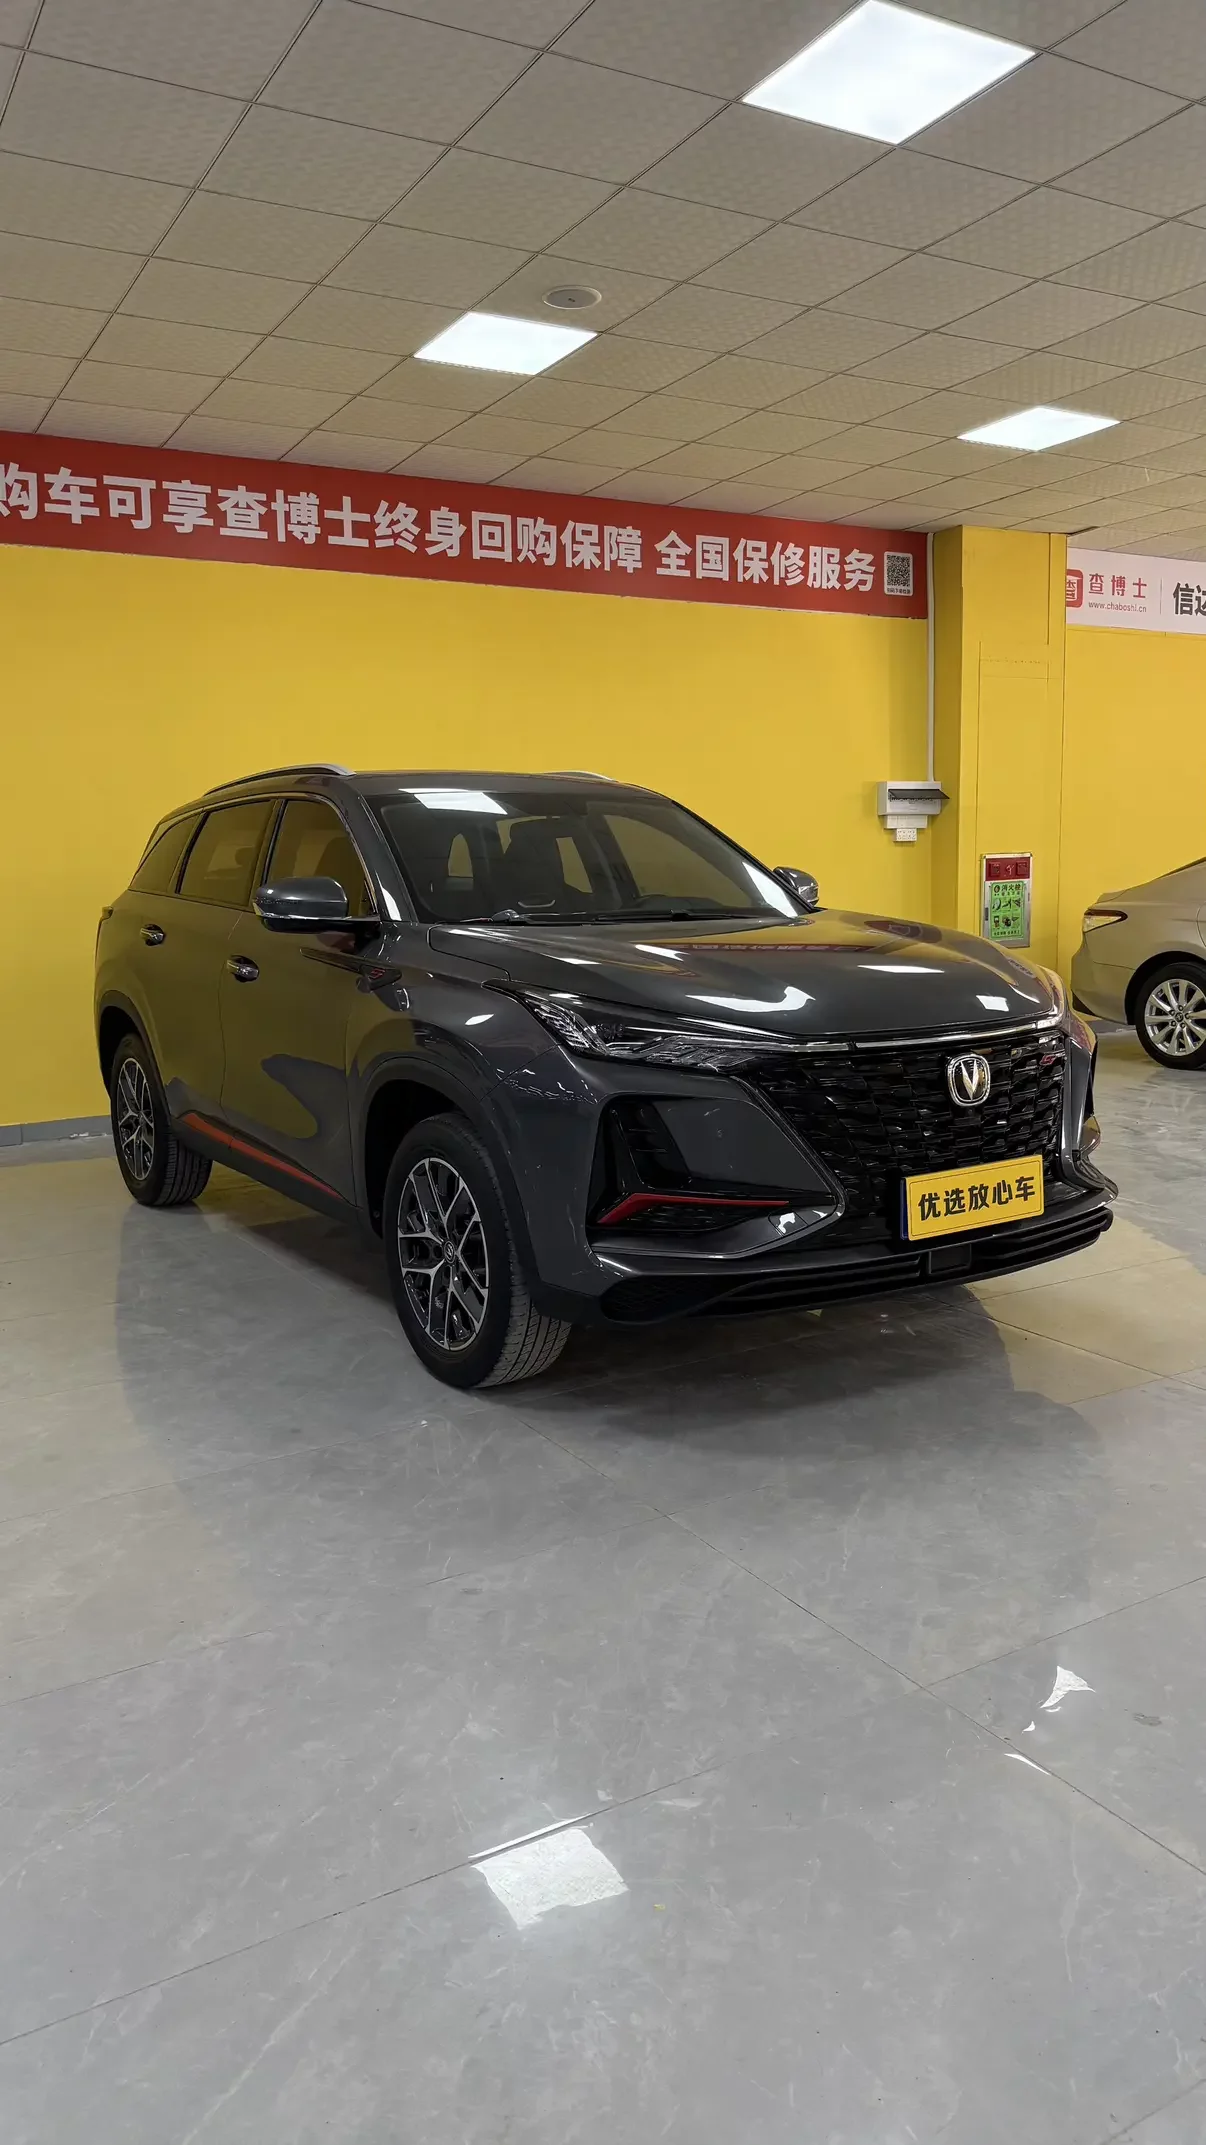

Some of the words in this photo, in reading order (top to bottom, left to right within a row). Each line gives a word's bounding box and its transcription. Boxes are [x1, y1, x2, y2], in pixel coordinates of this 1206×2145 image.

[0, 461, 642, 574] 购车可享查博士终身回购保障
[655, 531, 876, 592] 全国保修服务
[1088, 573, 1148, 599] 查博士
[1088, 601, 1148, 613] www.chaboshi.cn
[917, 1176, 1036, 1221] 优选放心车
